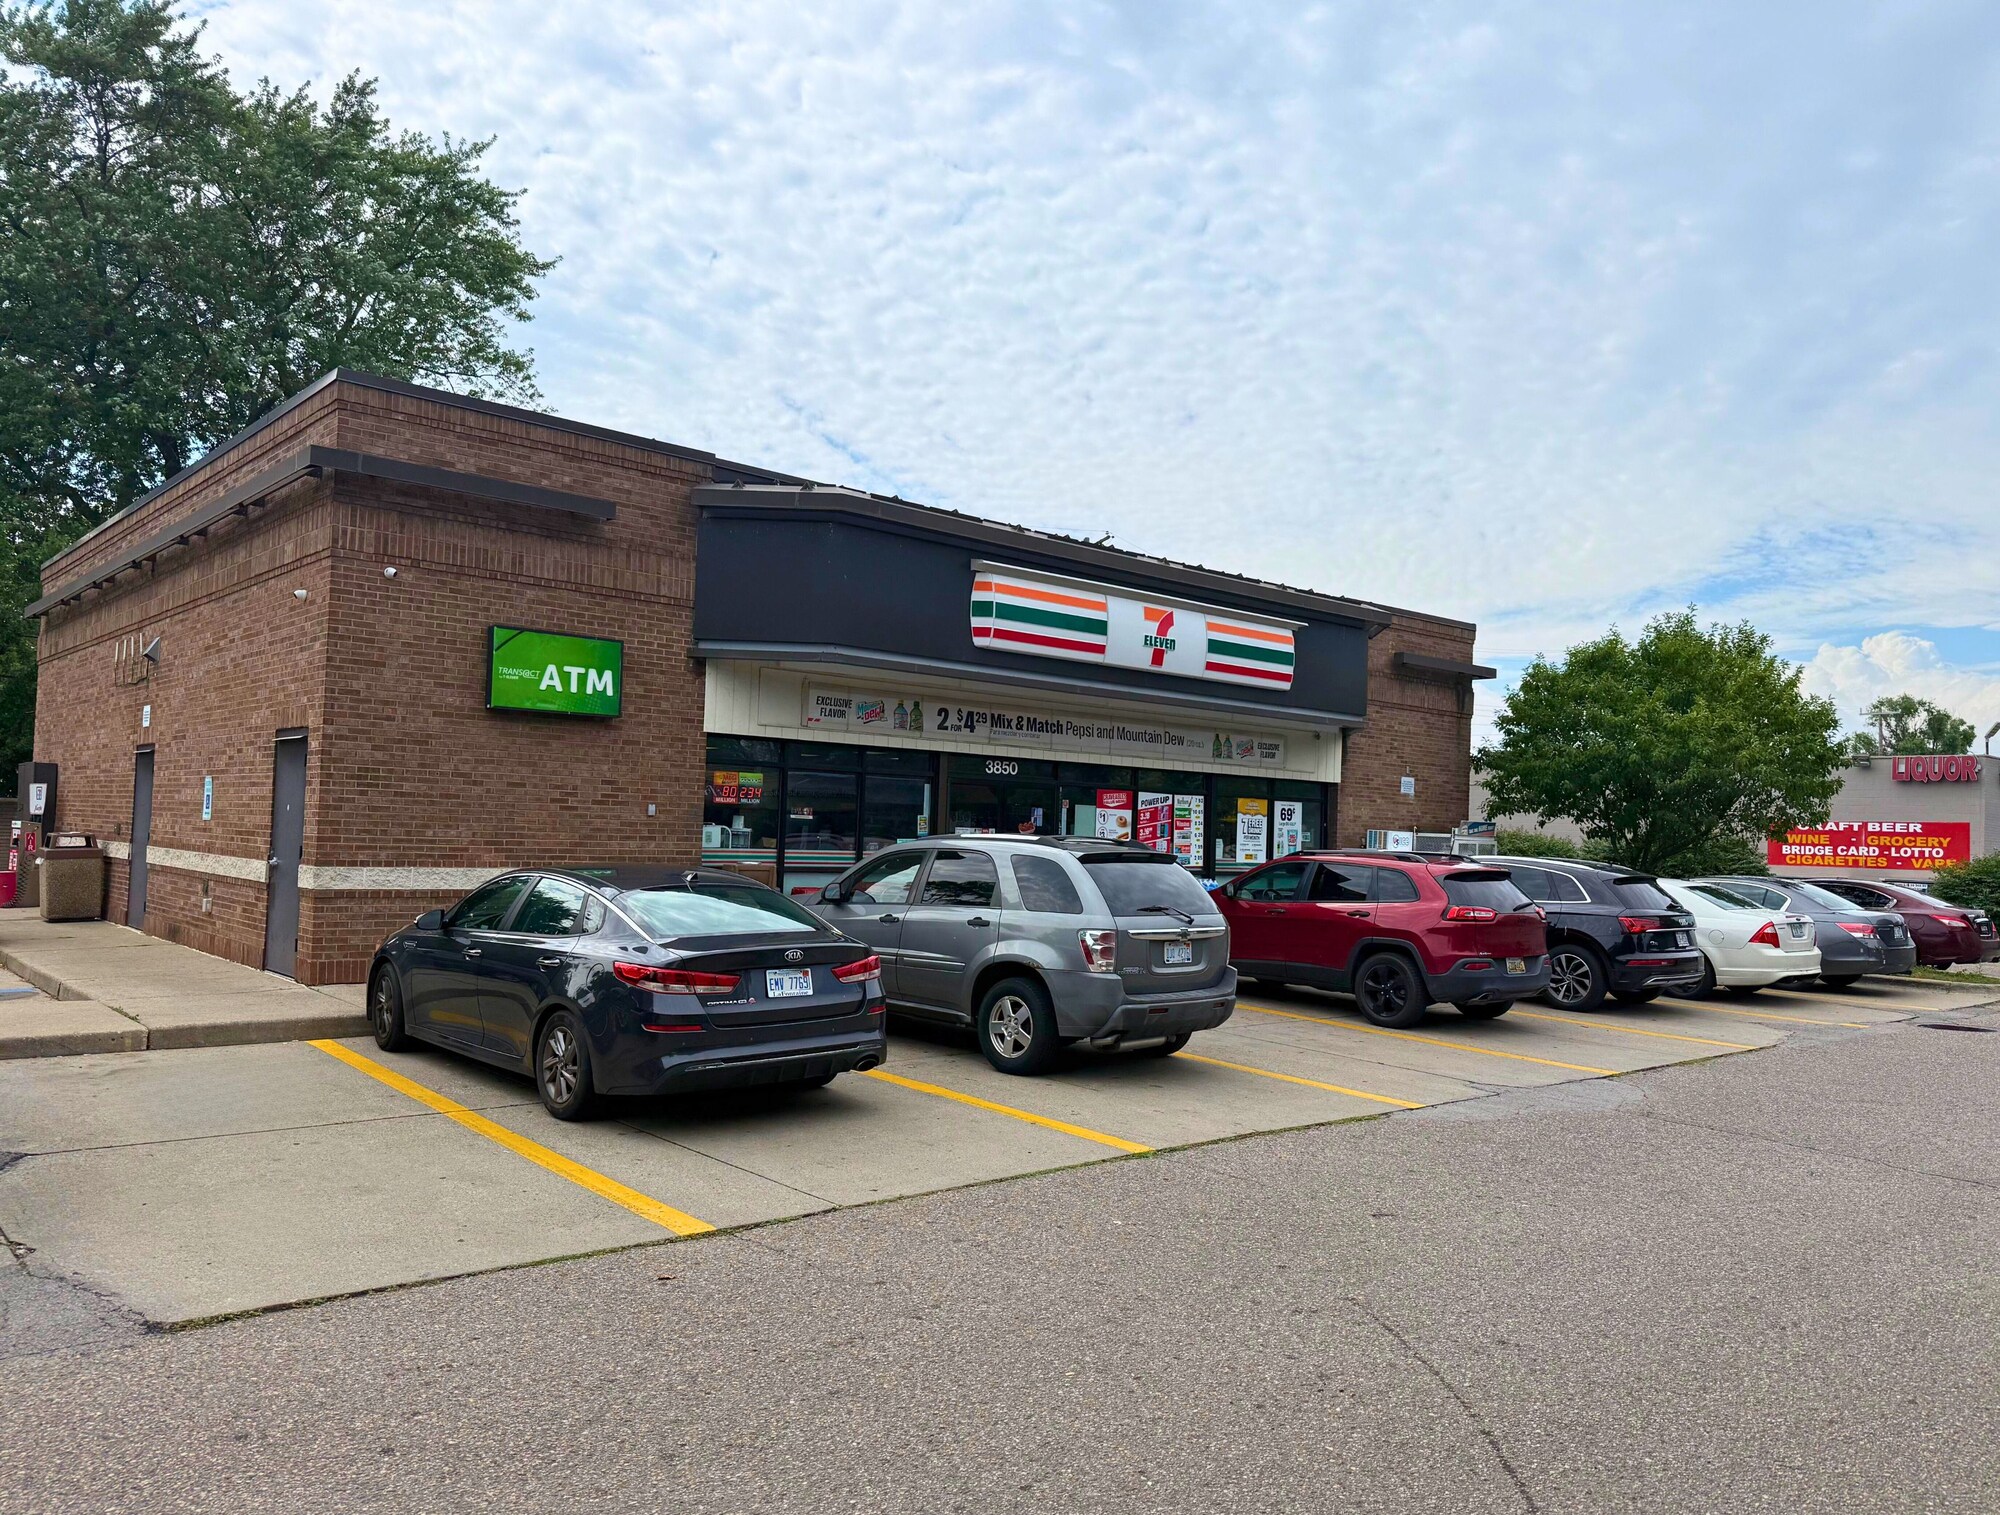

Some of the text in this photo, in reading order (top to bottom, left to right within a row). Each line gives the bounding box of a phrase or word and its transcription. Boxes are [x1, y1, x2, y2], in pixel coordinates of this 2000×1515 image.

[1143, 606, 1175, 667] 7
[539, 664, 614, 696] ATM
[816, 695, 852, 709] EXCLUSIVE
[820, 707, 847, 719] FLAVOR
[937, 707, 950, 731] 2
[951, 724, 963, 732] FOR
[990, 713, 1014, 730] Mix
[1015, 716, 1024, 731] &
[1026, 717, 1064, 735] Match
[1066, 721, 1094, 740] Pepsi
[1096, 726, 1115, 740] and
[1116, 726, 1163, 745] Mountain
[1164, 731, 1185, 746] Dew
[985, 760, 1018, 775] 3850
[1892, 755, 1978, 784] LIQUOR
[722, 786, 762, 798] 80 234
[1140, 796, 1170, 807] POWER UP
[1868, 822, 1922, 833] BEER
[1787, 834, 1830, 845] WINE
[1867, 836, 1951, 847] GROCERY
[1782, 846, 1833, 856] BRIDGE
[1837, 847, 1879, 857] CARD
[1891, 848, 1944, 858] LOTTO
[1785, 855, 1887, 868] CIGARETTES
[788, 952, 802, 960] KIA
[769, 976, 809, 991] EMV 7769
